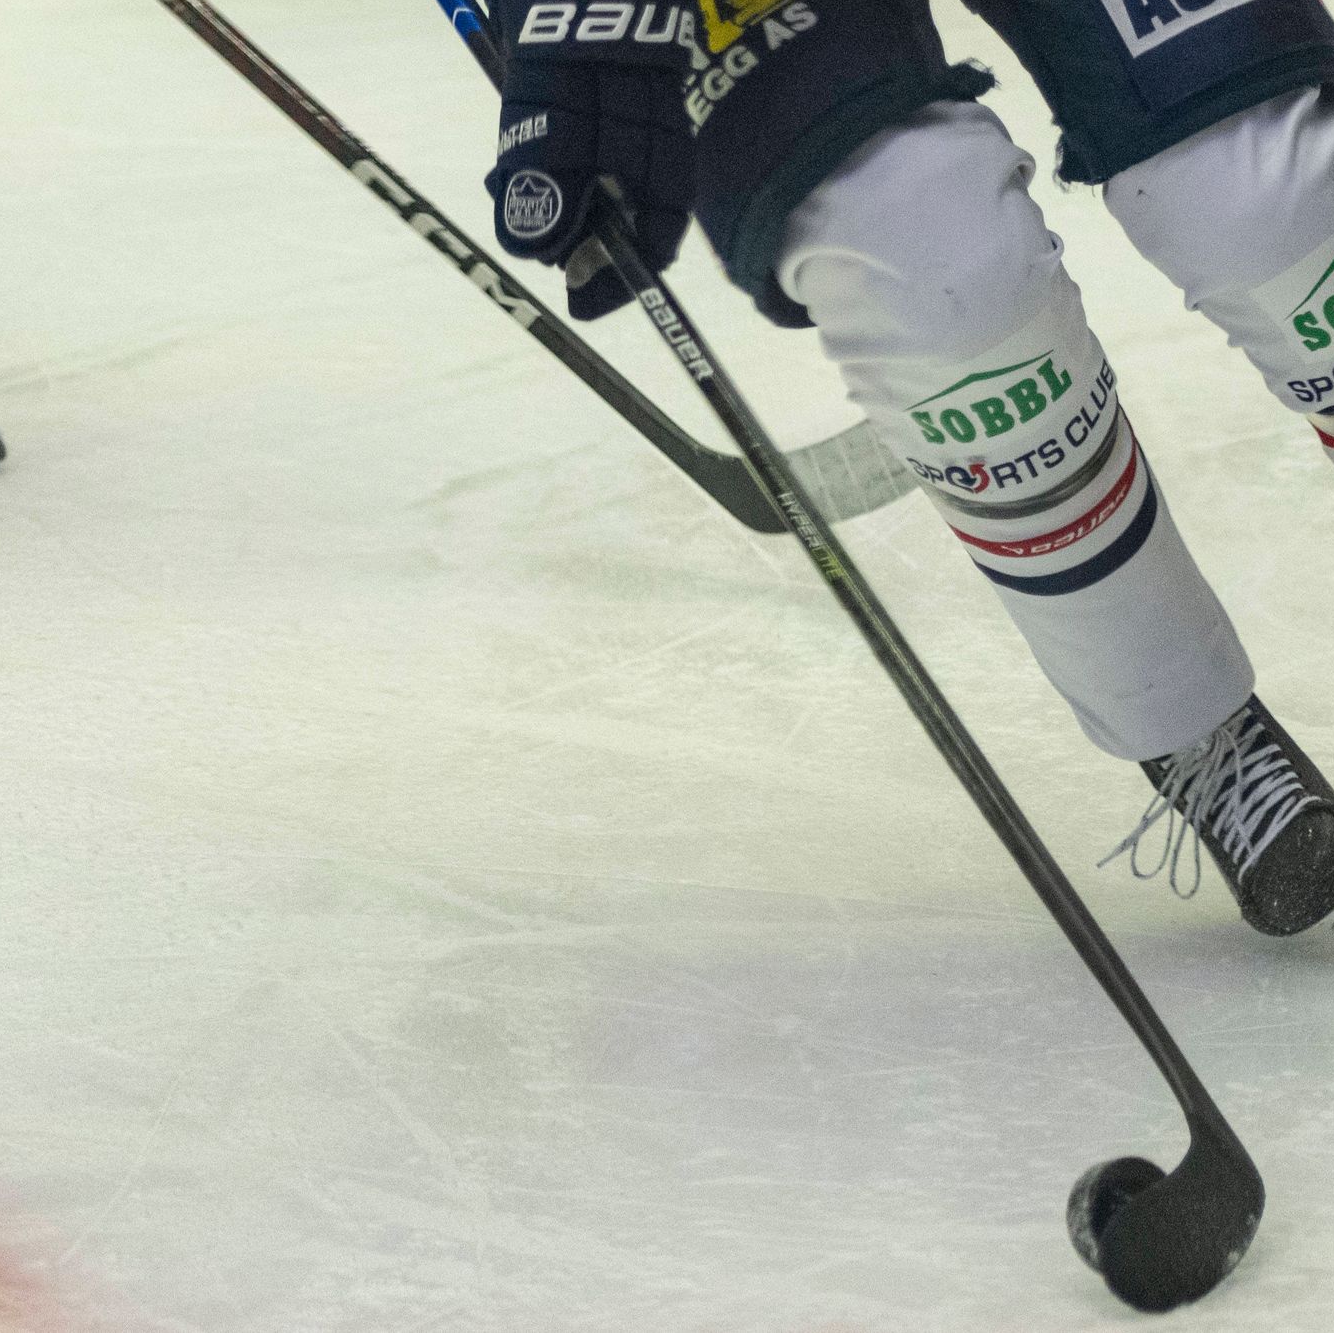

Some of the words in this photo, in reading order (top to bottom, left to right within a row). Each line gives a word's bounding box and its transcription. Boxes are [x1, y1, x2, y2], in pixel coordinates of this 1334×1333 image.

[763, 2, 818, 51] AS
[640, 287, 714, 380] BAUER
[906, 438, 1066, 494] SPORTS
[1065, 358, 1115, 448] CLUB
[910, 357, 1073, 445] SOBBL
